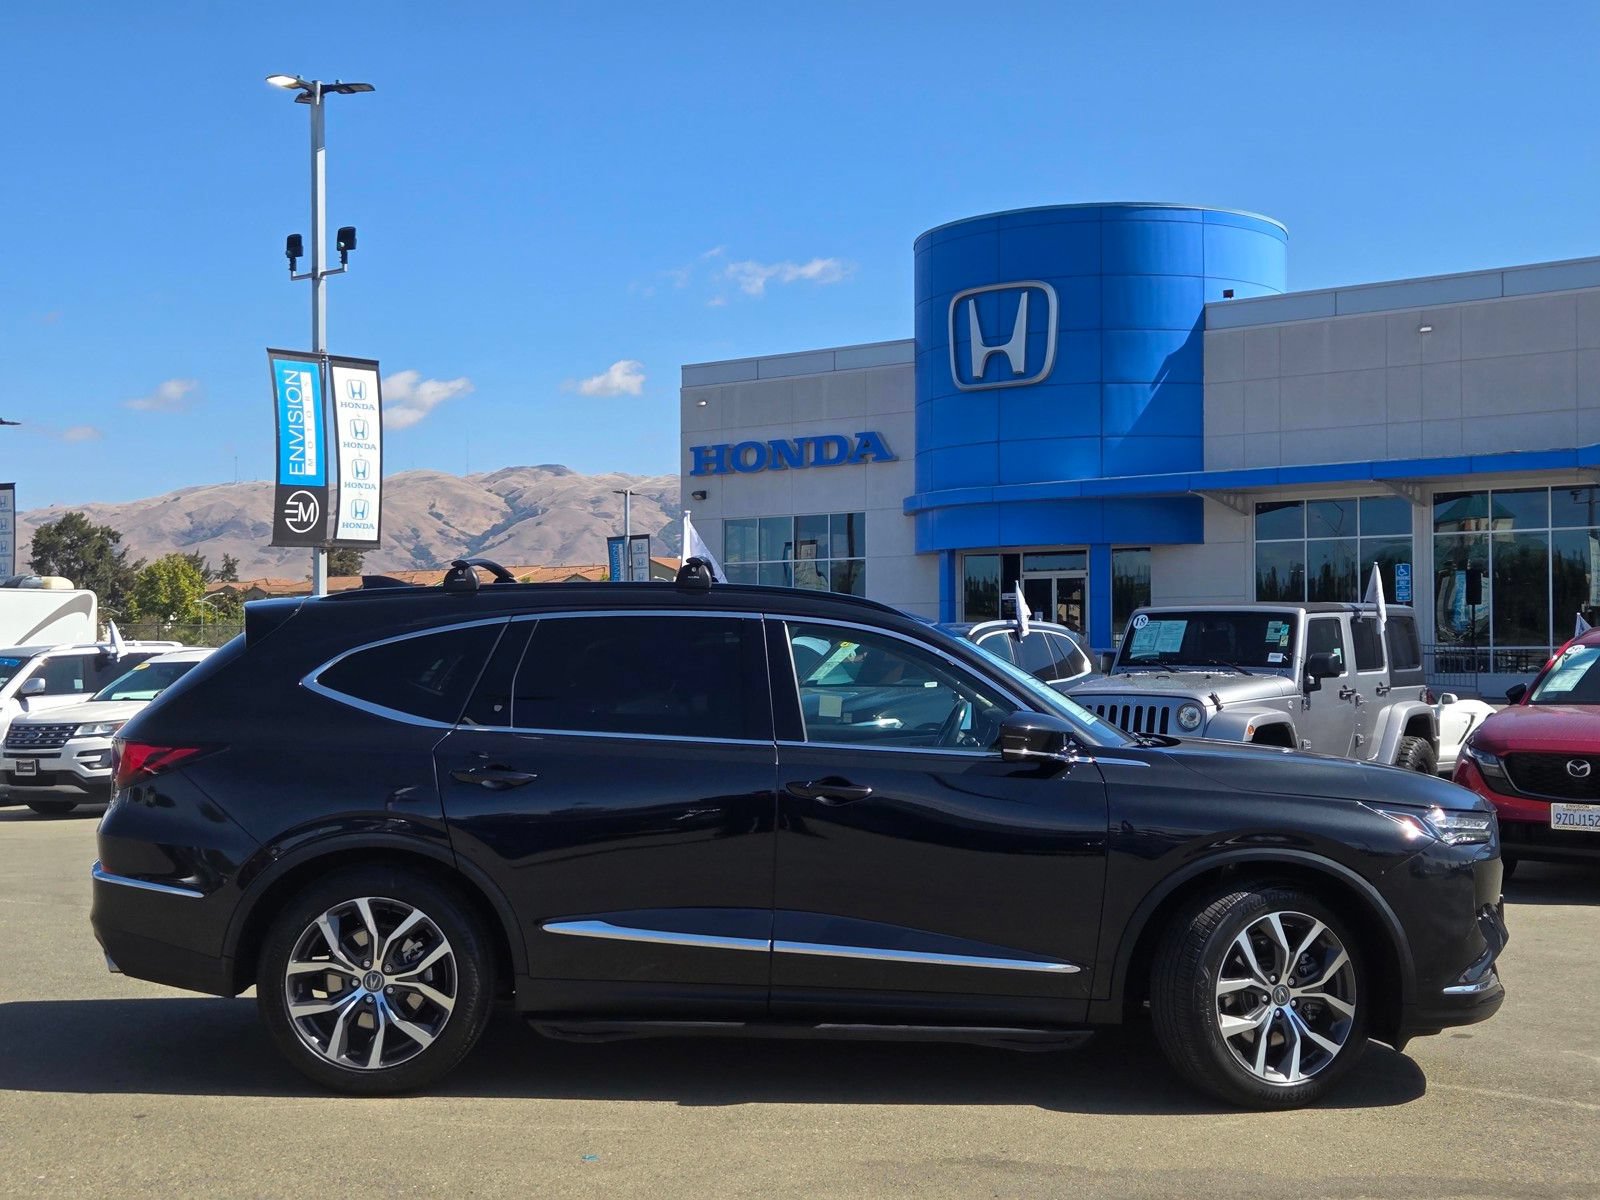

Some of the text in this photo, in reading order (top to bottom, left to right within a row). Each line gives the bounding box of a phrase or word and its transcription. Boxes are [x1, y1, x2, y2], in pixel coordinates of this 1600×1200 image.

[340, 401, 376, 411] HONDA
[284, 369, 305, 476] ENVISION
[343, 441, 377, 450] HONDA
[689, 431, 899, 477] HONDA
[344, 481, 377, 490] HONDA
[342, 521, 375, 530] HONDA
[1135, 616, 1147, 627] 18
